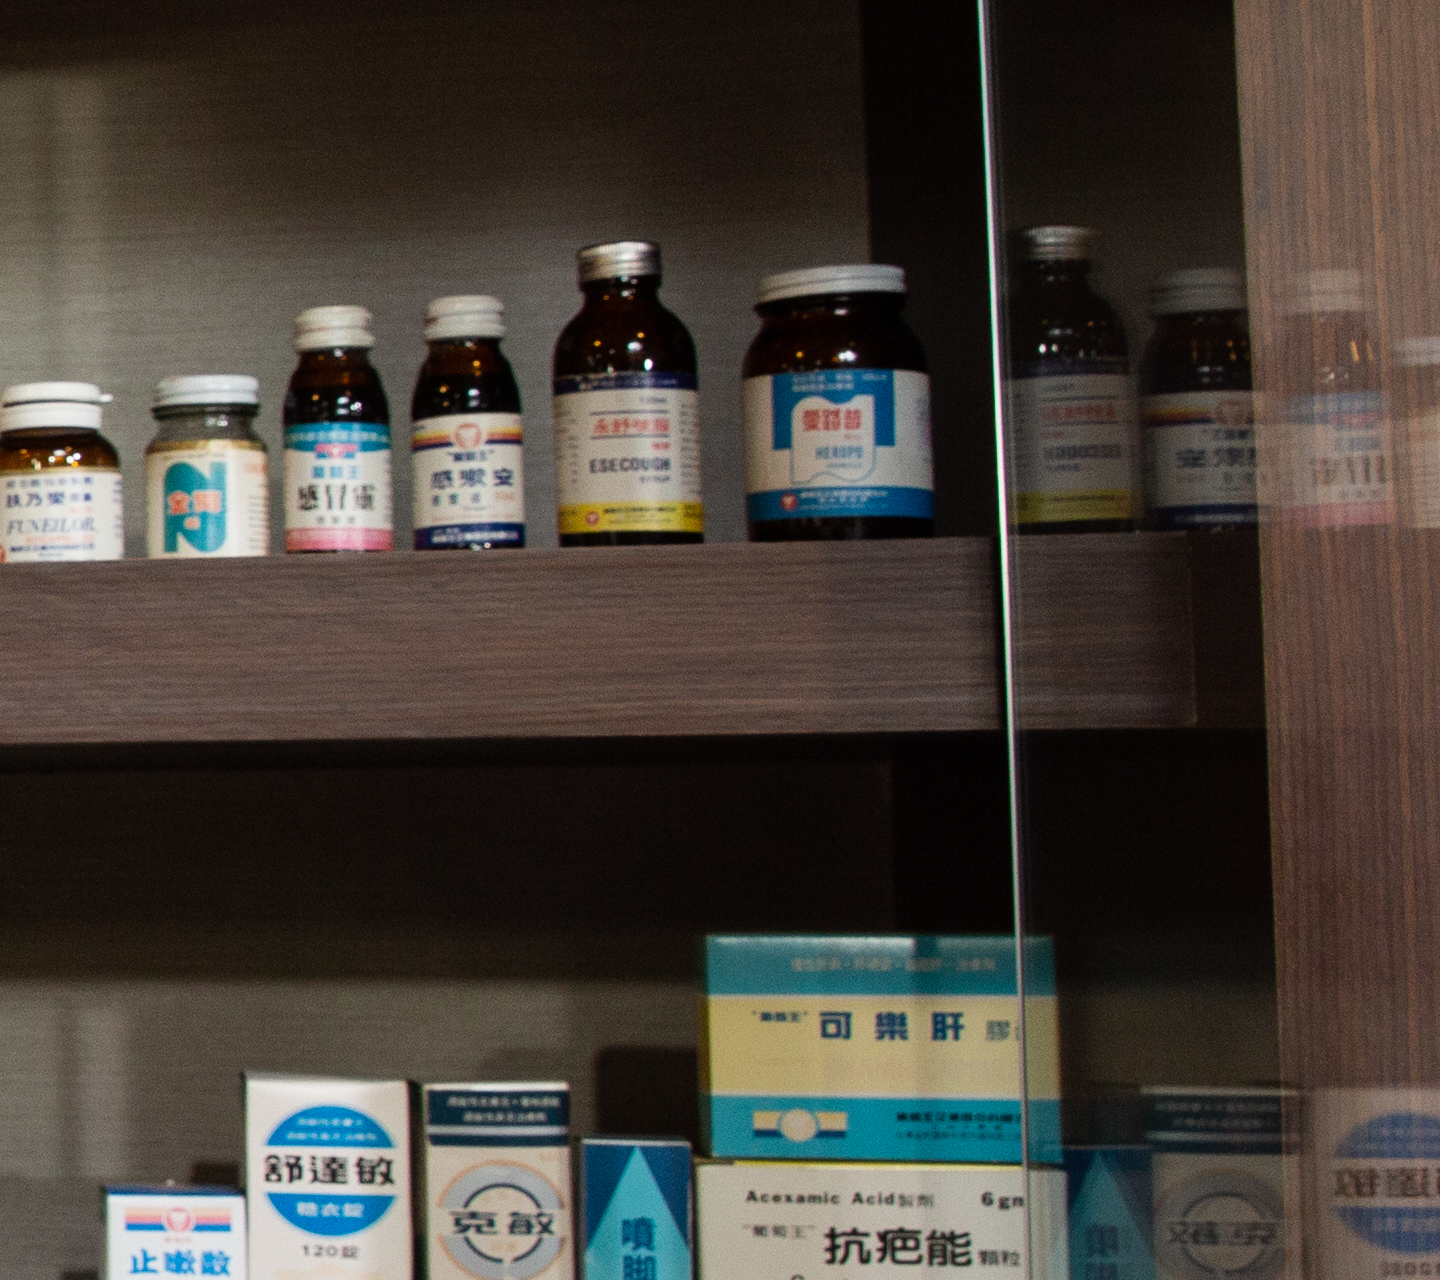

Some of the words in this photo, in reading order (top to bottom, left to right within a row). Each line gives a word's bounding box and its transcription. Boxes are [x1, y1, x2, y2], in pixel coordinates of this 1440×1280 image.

[819, 1010, 965, 1041] 可樂肝
[986, 1020, 1022, 1042] 膠
[264, 1154, 396, 1186] 舒達敏
[745, 1190, 840, 1205] Acexamic
[824, 1226, 973, 1267] 抗疤能
